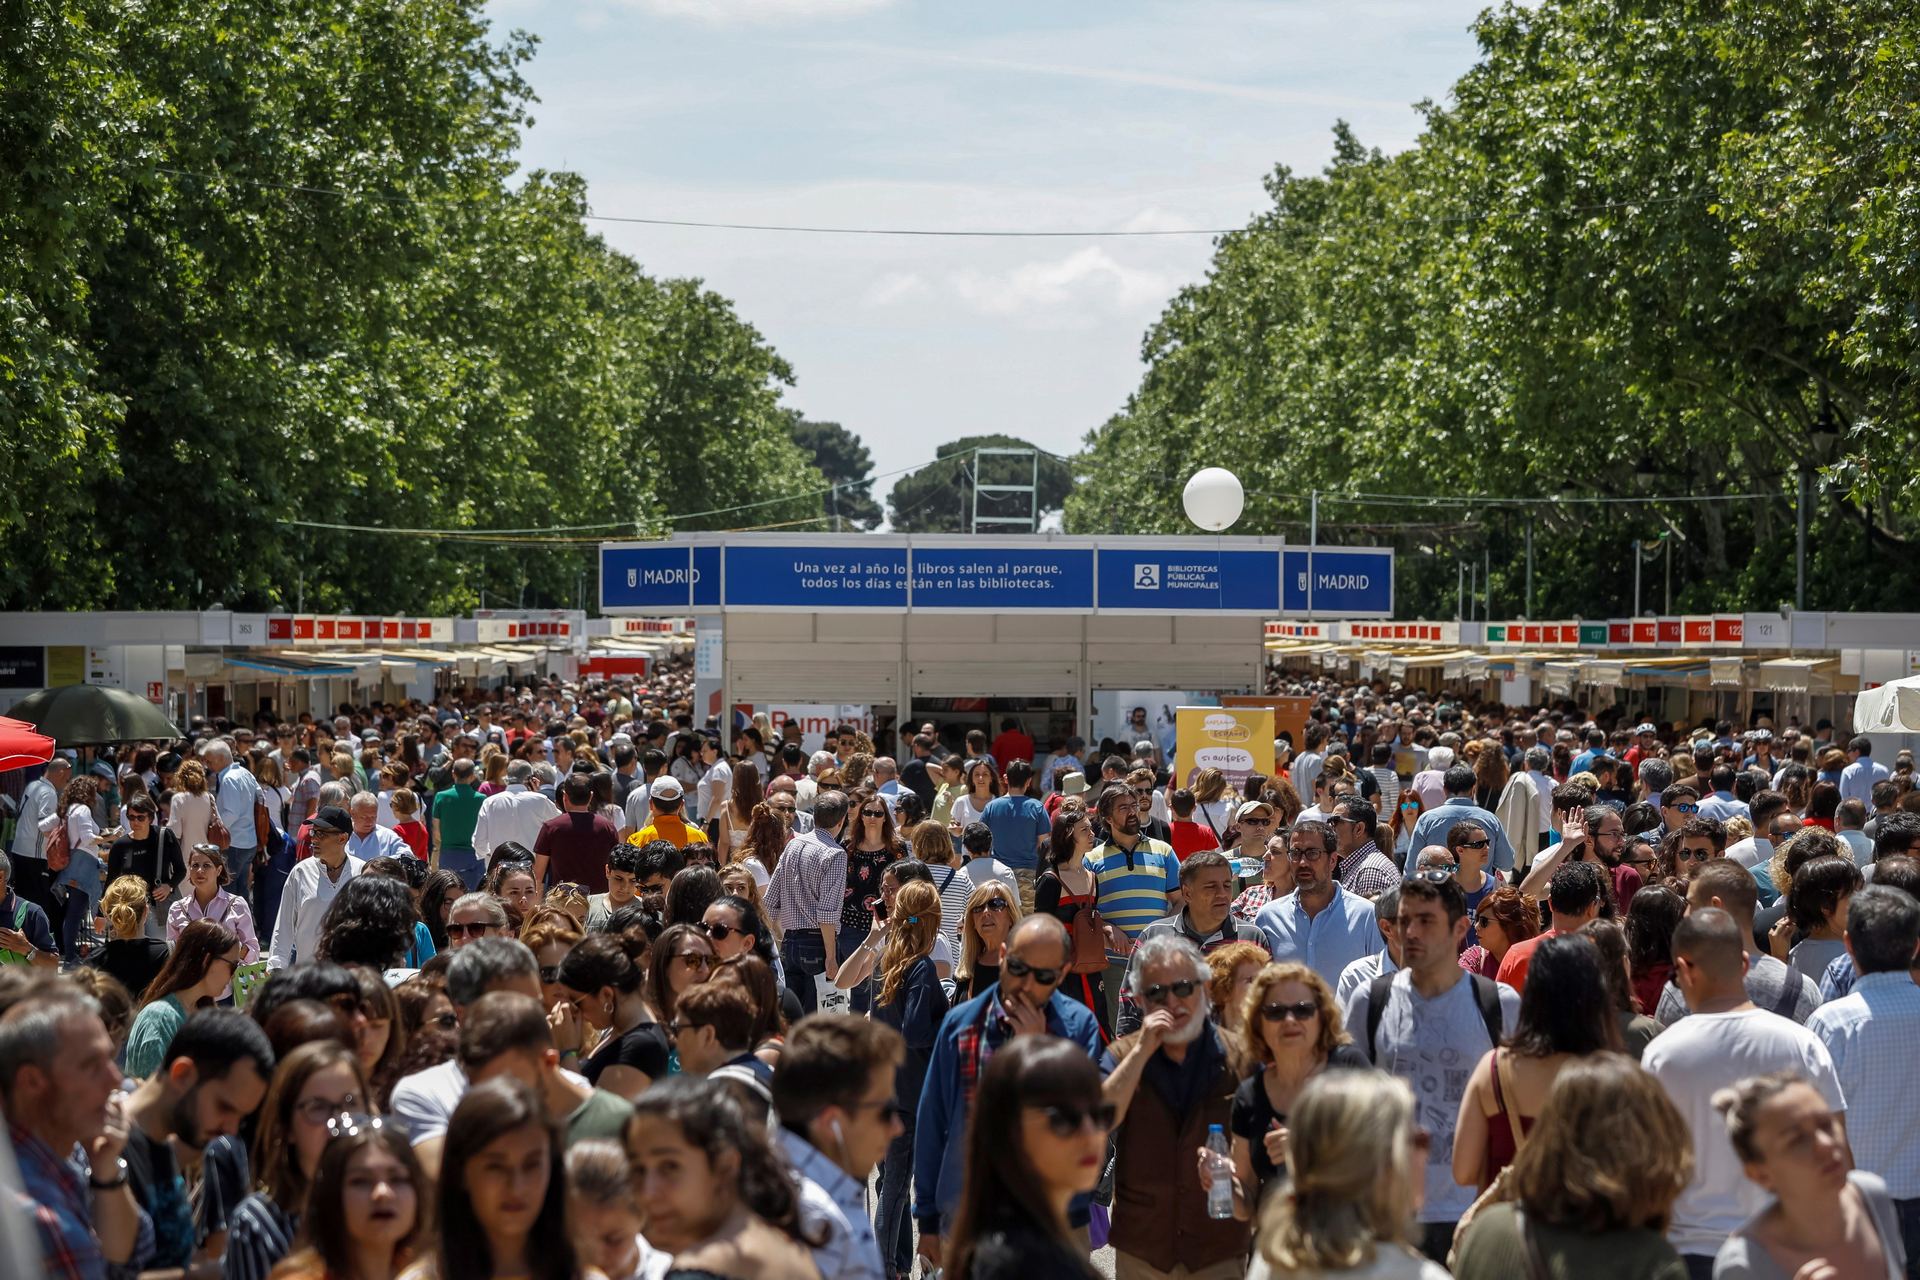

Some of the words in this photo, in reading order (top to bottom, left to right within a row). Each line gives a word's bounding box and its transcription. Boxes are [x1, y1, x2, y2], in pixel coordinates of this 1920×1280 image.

[794, 562, 819, 573] Una
[823, 565, 845, 574] vez
[850, 563, 861, 574] al
[865, 563, 890, 574] año
[894, 563, 913, 574] lo
[918, 563, 955, 574] libros
[959, 563, 993, 574] salen
[997, 563, 1009, 574] al
[1013, 564, 1062, 576] parque,
[1167, 565, 1218, 573] BIBLIOTECAS
[644, 568, 701, 585] MADRID
[1167, 572, 1206, 581] PÚBLICAS
[1318, 574, 1369, 590] MADRID
[802, 578, 838, 588] todos
[842, 577, 861, 589] los
[865, 577, 891, 589] días
[937, 581, 953, 589] en
[957, 578, 975, 589] las
[979, 577, 1055, 589] bibliotecas.
[240, 623, 253, 634] 363
[1759, 625, 1773, 636] 121
[771, 711, 877, 734] Rmaní
[1212, 753, 1248, 763] QUIERES
